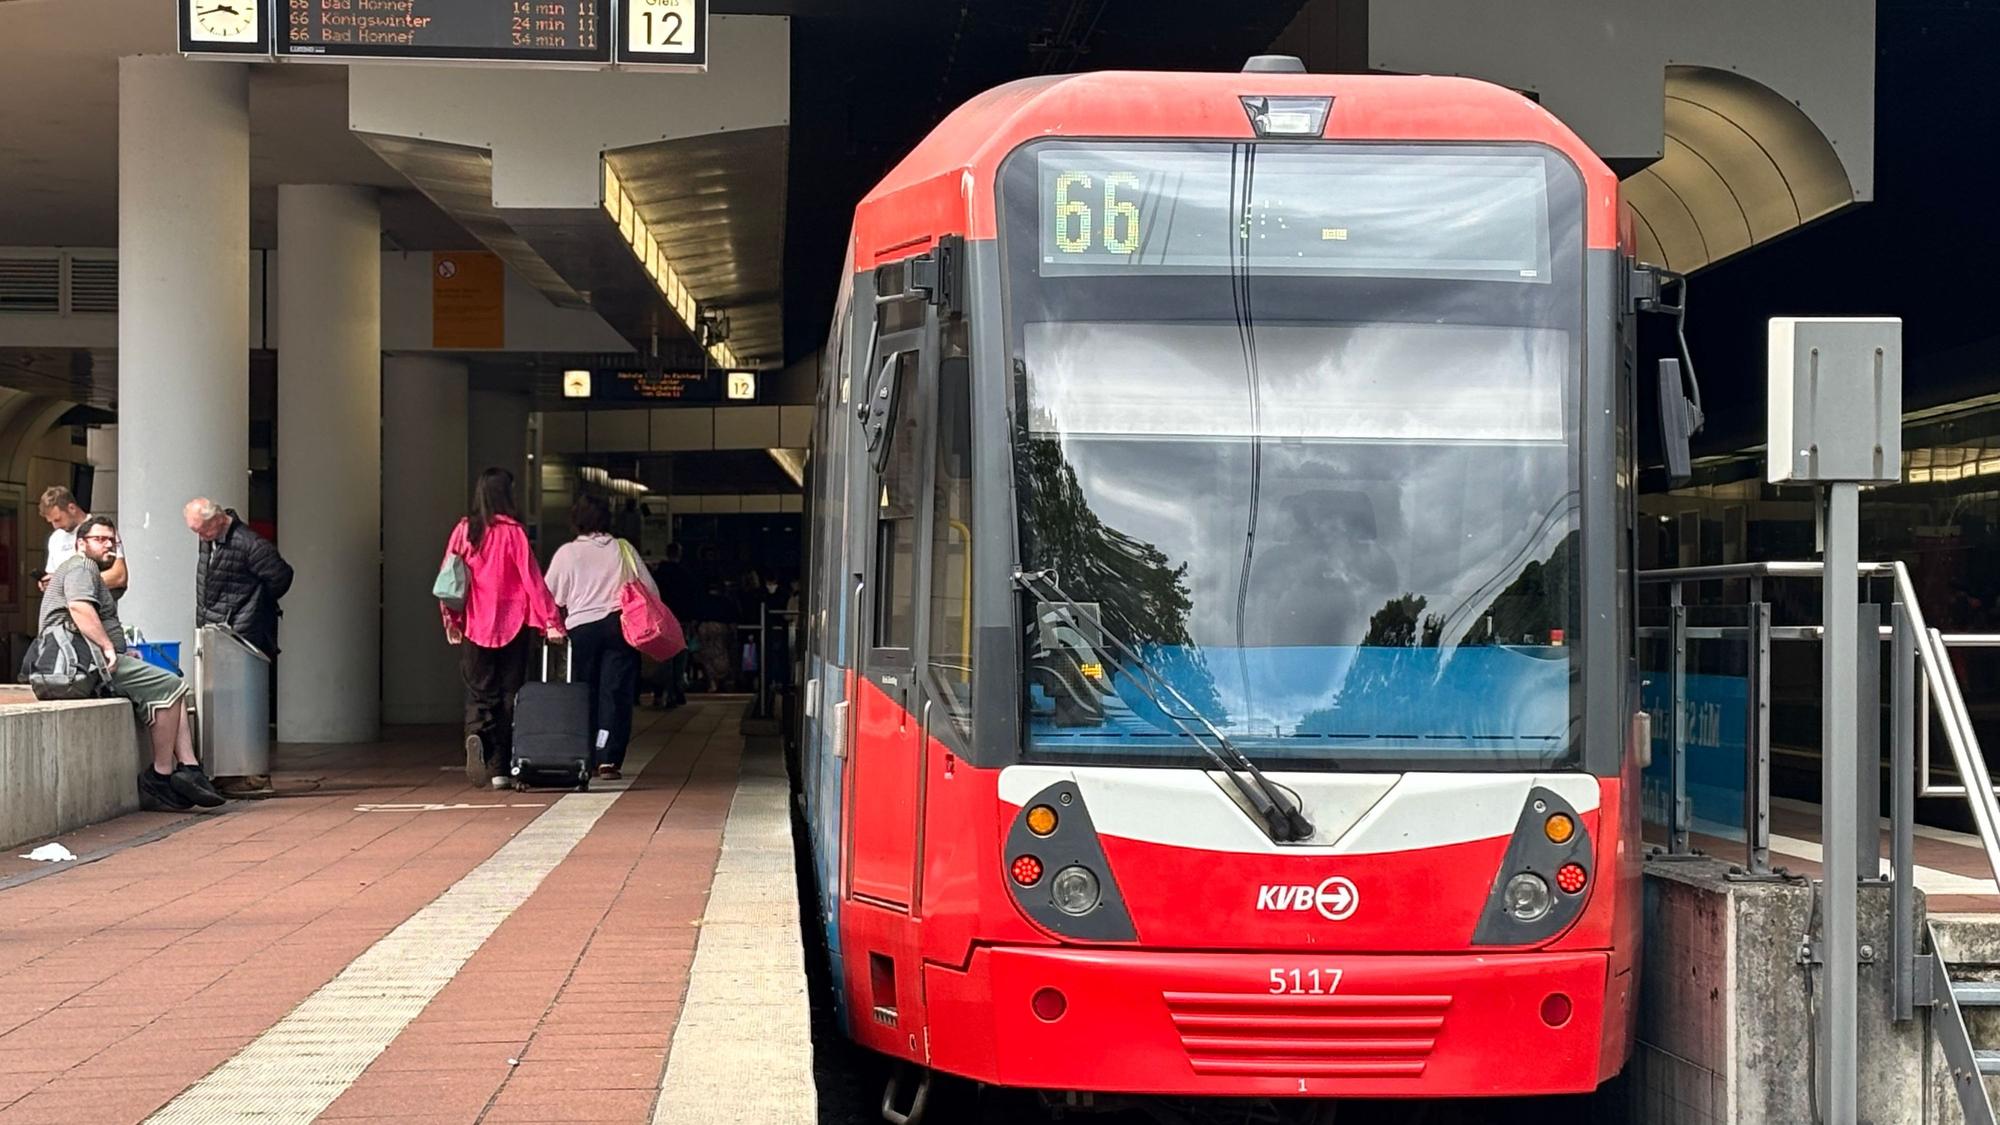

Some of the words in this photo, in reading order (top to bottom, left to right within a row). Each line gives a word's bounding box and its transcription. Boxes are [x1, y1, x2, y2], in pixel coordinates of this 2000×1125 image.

[290, 0, 309, 9] 66
[321, 0, 351, 9] Bad
[359, 0, 414, 13] Honnef
[513, 2, 530, 14] 14
[536, 3, 565, 15] min
[579, 2, 594, 15] 11
[290, 11, 309, 25] 66
[512, 17, 530, 30] 24
[536, 17, 565, 31] min
[579, 18, 594, 32] 11
[642, 12, 683, 46] 12
[290, 27, 310, 41] 66
[322, 28, 351, 42] Bad
[359, 29, 415, 45] Honnef
[512, 32, 530, 46] 34
[536, 33, 565, 47] min
[579, 34, 594, 48] 11
[1056, 171, 1139, 254] 66
[734, 382, 750, 395] 12
[1256, 885, 1316, 911] KVB
[1269, 968, 1344, 994] 5117
[1298, 1078, 1308, 1092] 1
